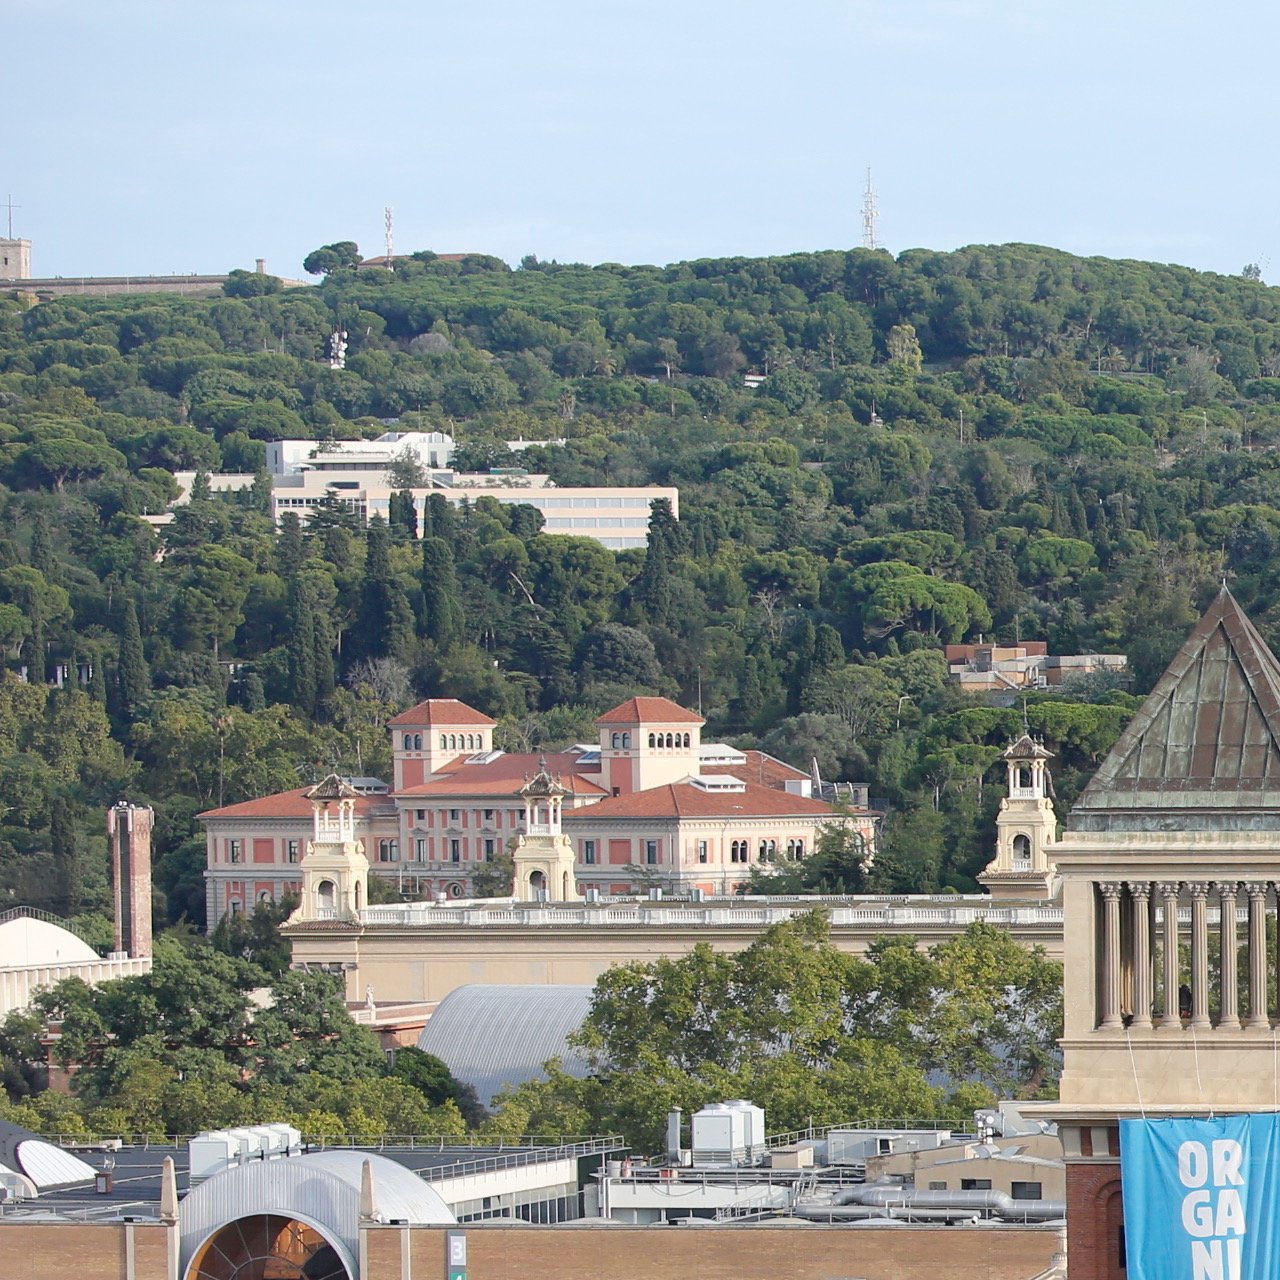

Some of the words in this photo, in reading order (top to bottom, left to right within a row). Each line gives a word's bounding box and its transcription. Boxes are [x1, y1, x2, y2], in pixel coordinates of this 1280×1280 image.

[1178, 1139, 1244, 1187] OR
[1182, 1189, 1245, 1237] GA
[453, 1241, 463, 1260] 3
